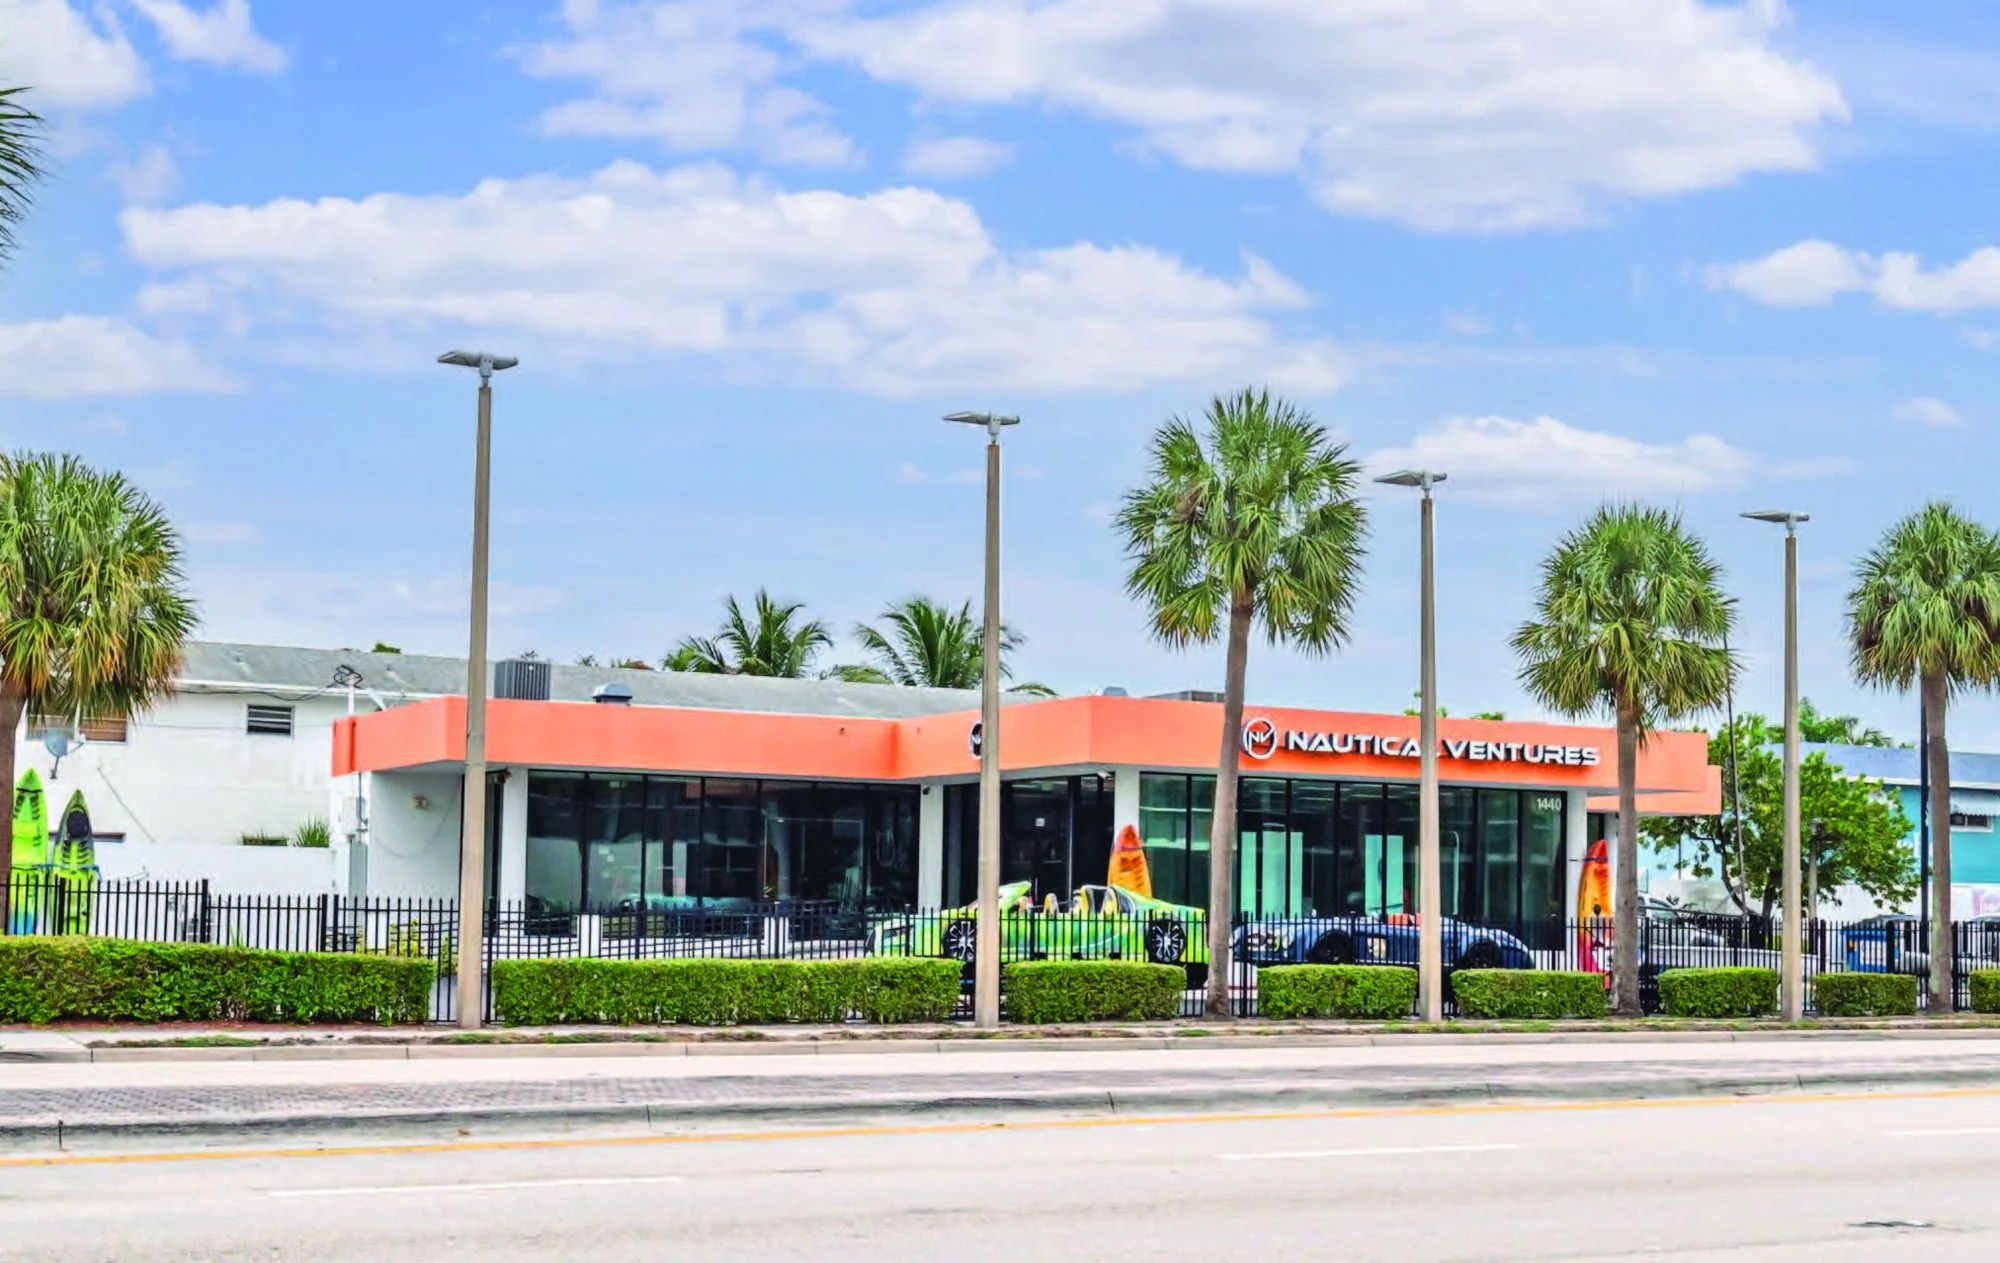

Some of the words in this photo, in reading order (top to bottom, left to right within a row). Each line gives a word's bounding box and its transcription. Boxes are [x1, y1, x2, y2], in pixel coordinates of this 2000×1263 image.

[1286, 730, 1440, 758] NAUTICA
[1443, 739, 1600, 766] VENTURES
[1536, 797, 1562, 811] 1440
